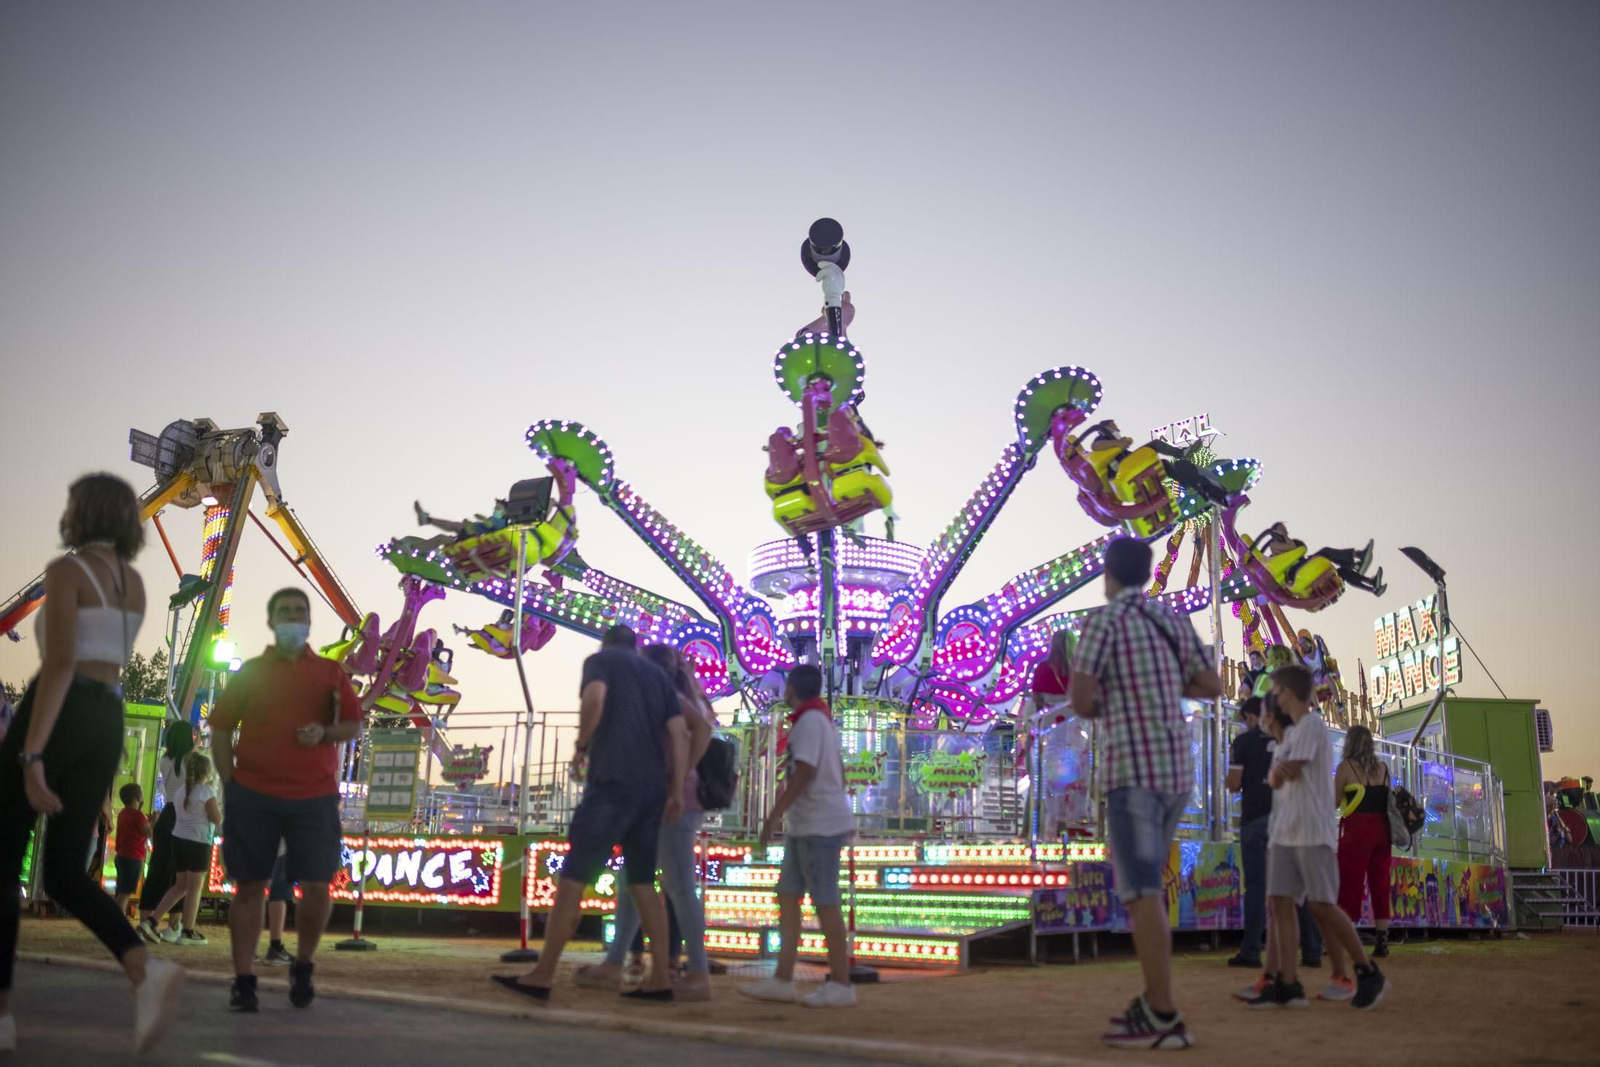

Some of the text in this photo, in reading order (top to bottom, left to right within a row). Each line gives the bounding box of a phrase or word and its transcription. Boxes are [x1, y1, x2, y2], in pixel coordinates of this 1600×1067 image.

[825, 627, 832, 639] 9
[1374, 593, 1449, 660] MAX
[1370, 636, 1462, 708] DANCE
[350, 849, 473, 889] DANCE
[1390, 865, 1419, 888] UPER
